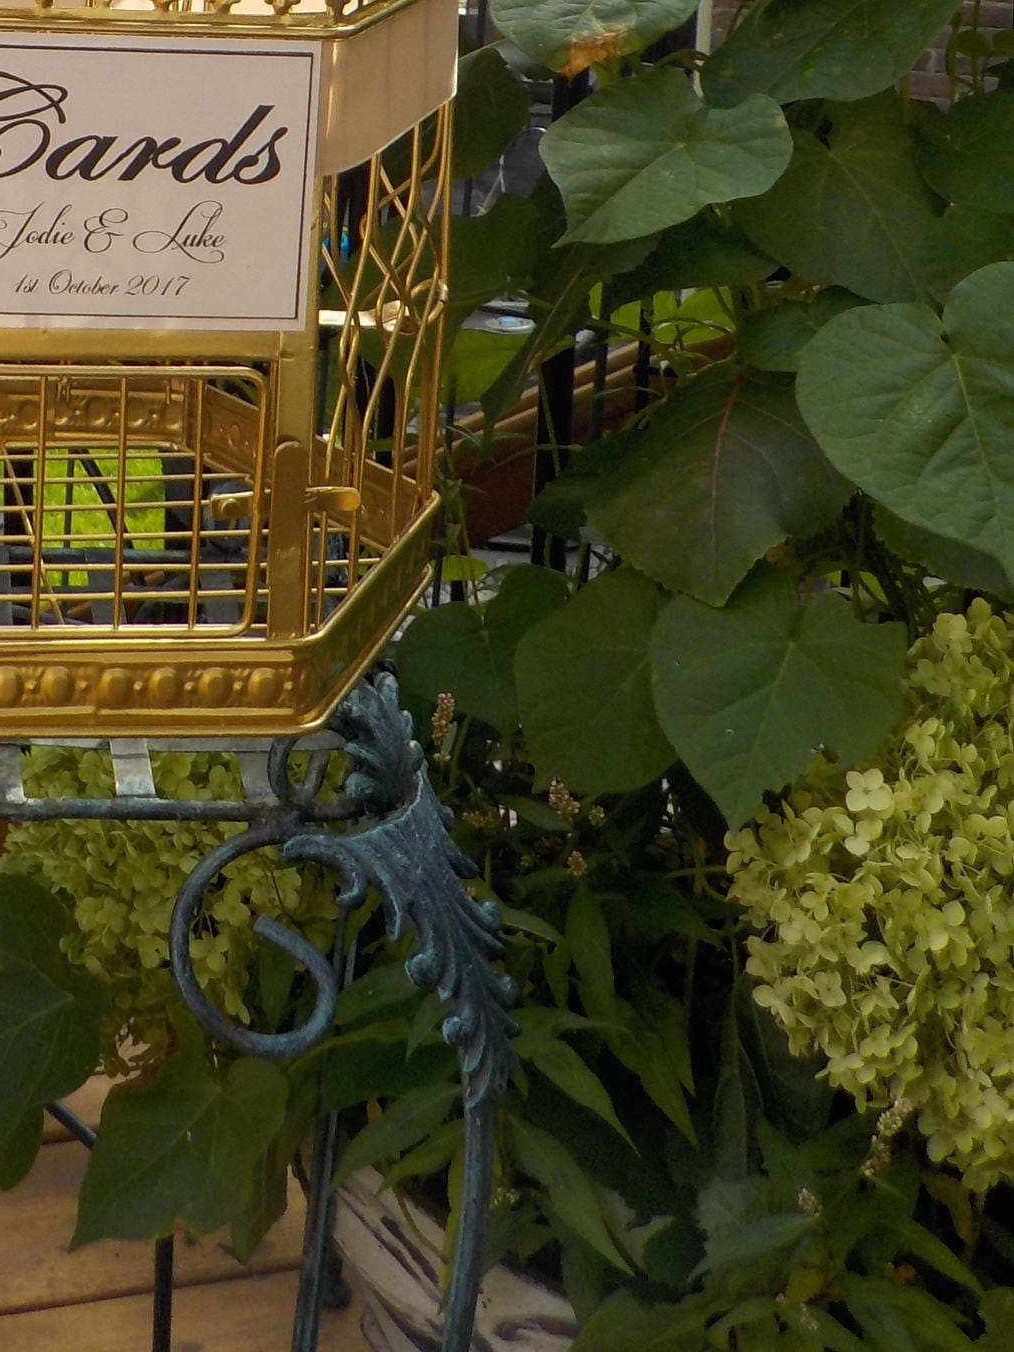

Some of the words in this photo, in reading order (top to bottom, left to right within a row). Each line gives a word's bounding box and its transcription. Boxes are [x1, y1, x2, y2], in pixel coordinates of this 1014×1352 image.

[84, 208, 129, 253] &
[133, 199, 227, 265] Luke
[14, 277, 39, 294] 1st
[48, 269, 120, 296] October
[124, 274, 192, 297] 2017
